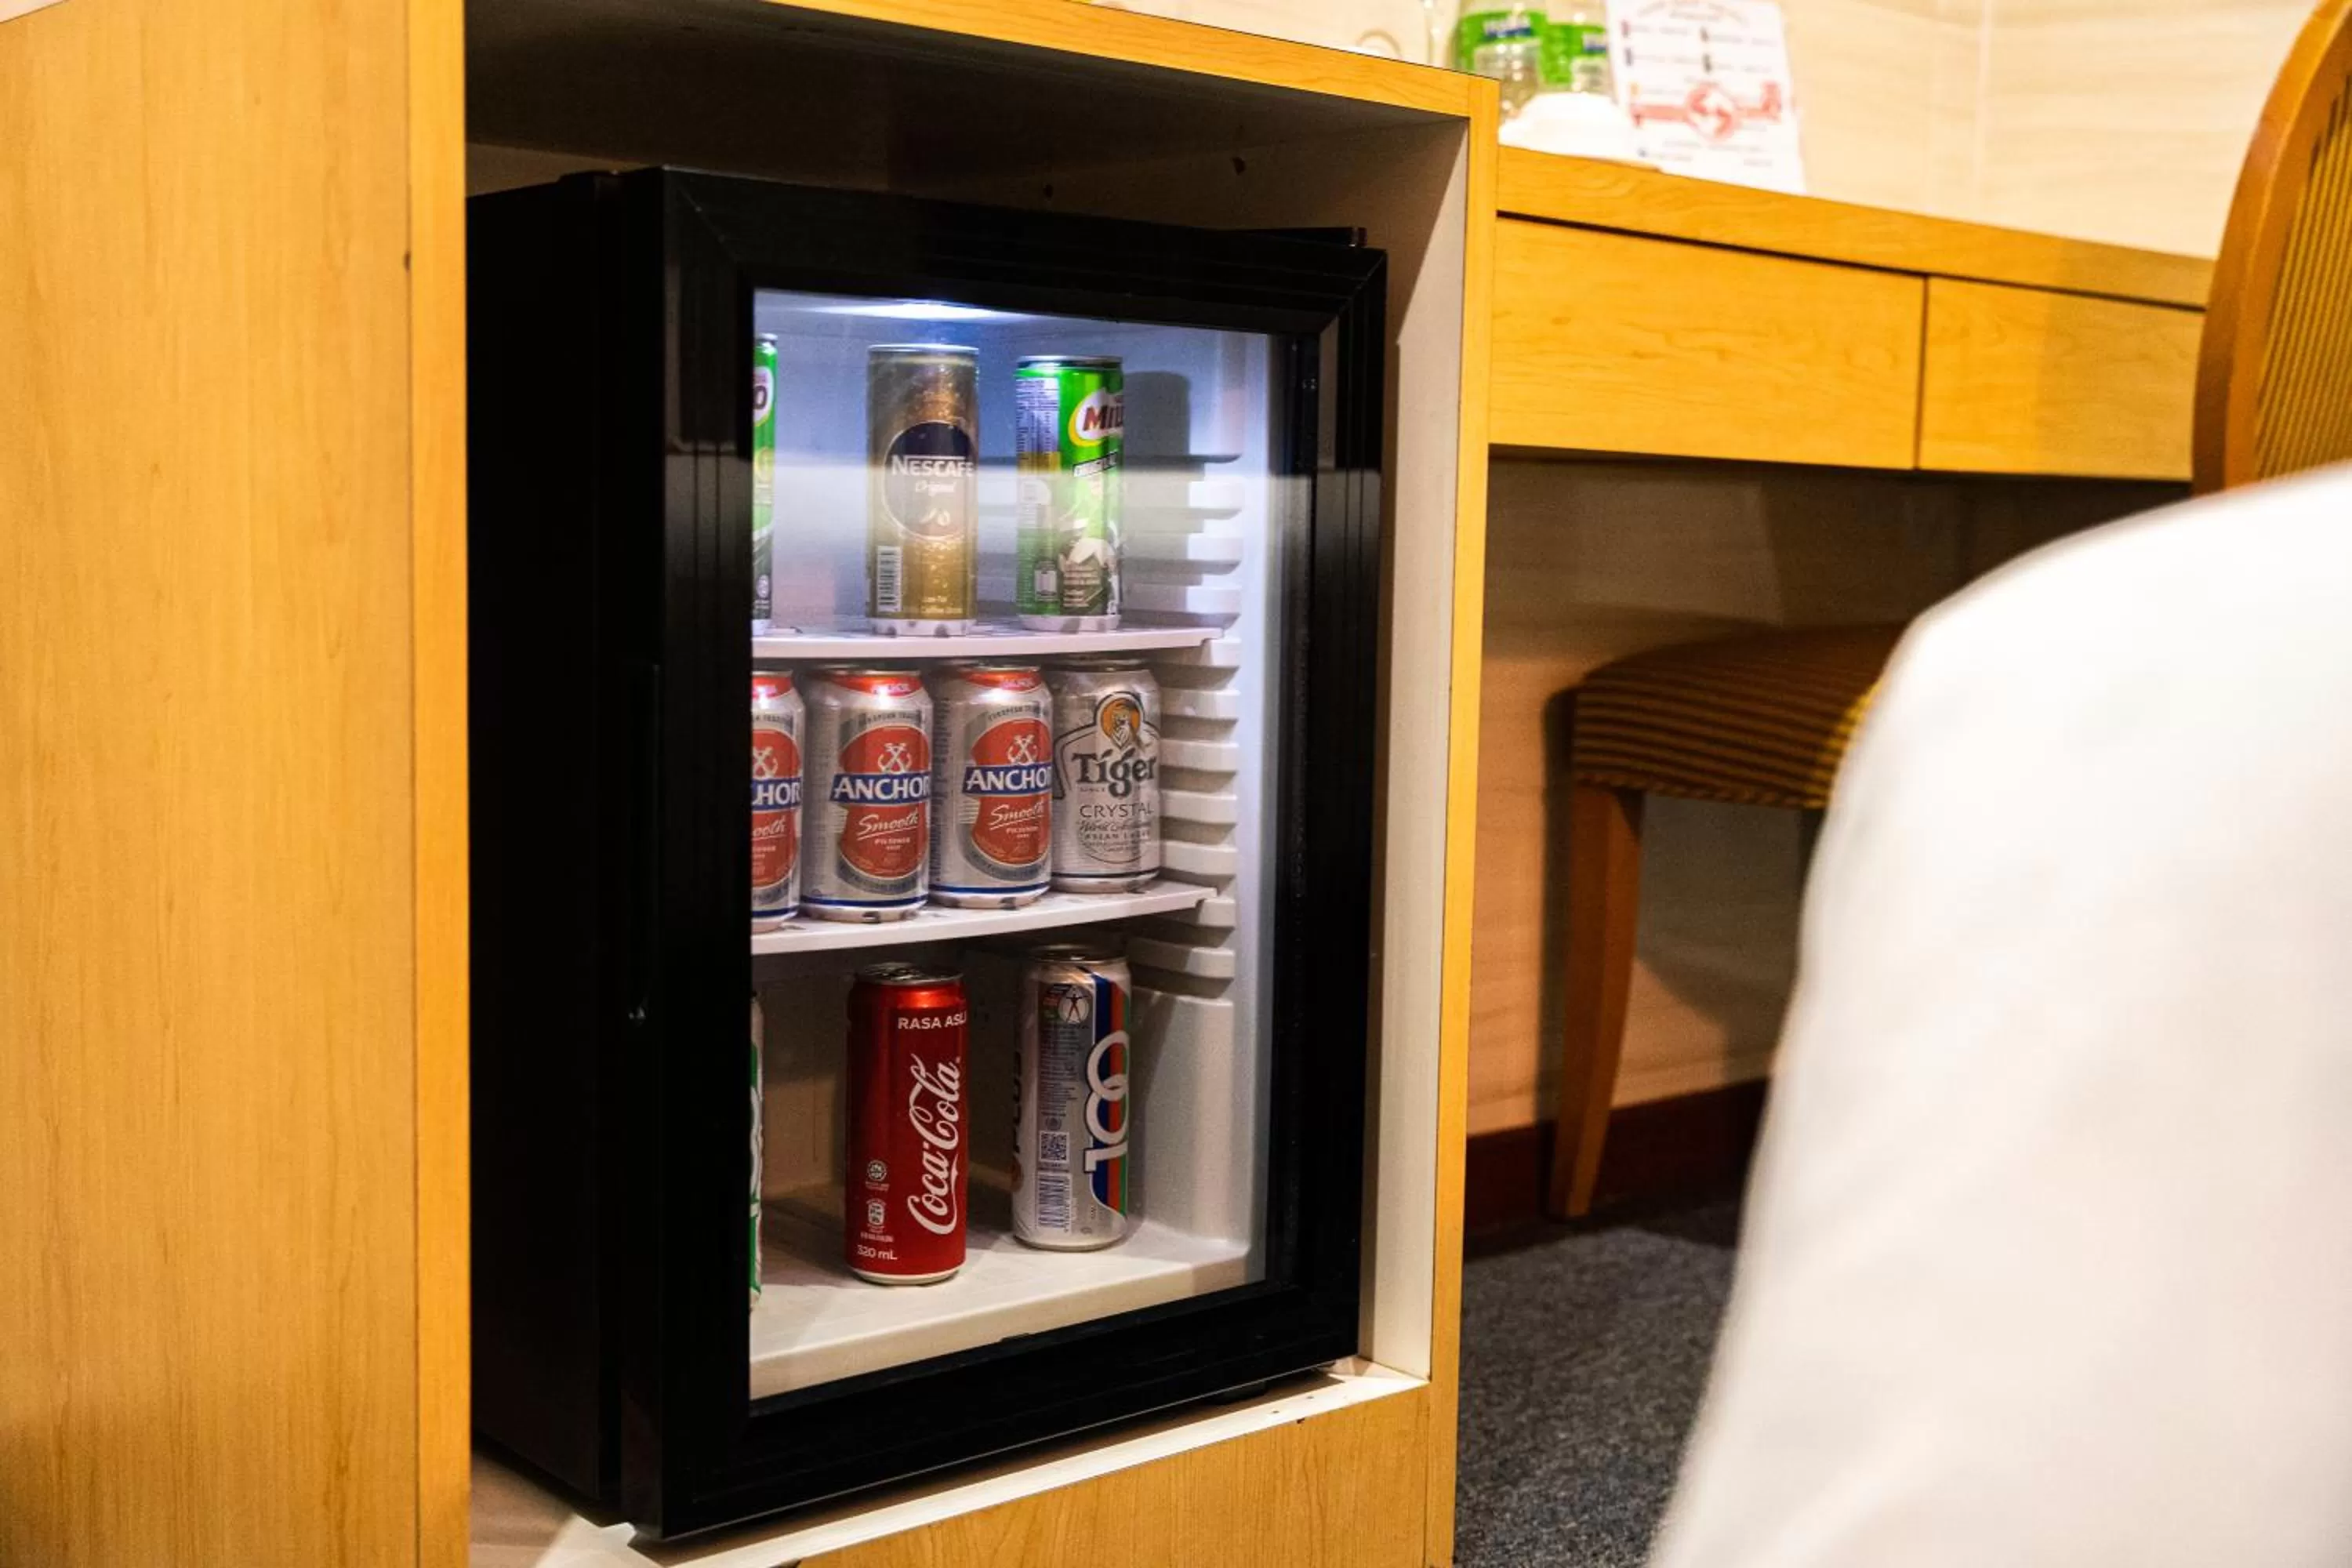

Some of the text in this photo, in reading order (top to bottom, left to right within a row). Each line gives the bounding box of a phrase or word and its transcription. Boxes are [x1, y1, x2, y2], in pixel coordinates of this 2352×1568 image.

[1082, 405, 1121, 431] MIL
[1071, 747, 1157, 797] Tiger
[856, 808, 919, 837] Smooth
[989, 797, 1044, 826] Smooth
[1079, 802, 1154, 818] CRYSTAL
[898, 1017, 942, 1029] RASA
[857, 1243, 898, 1260] 320 mL
